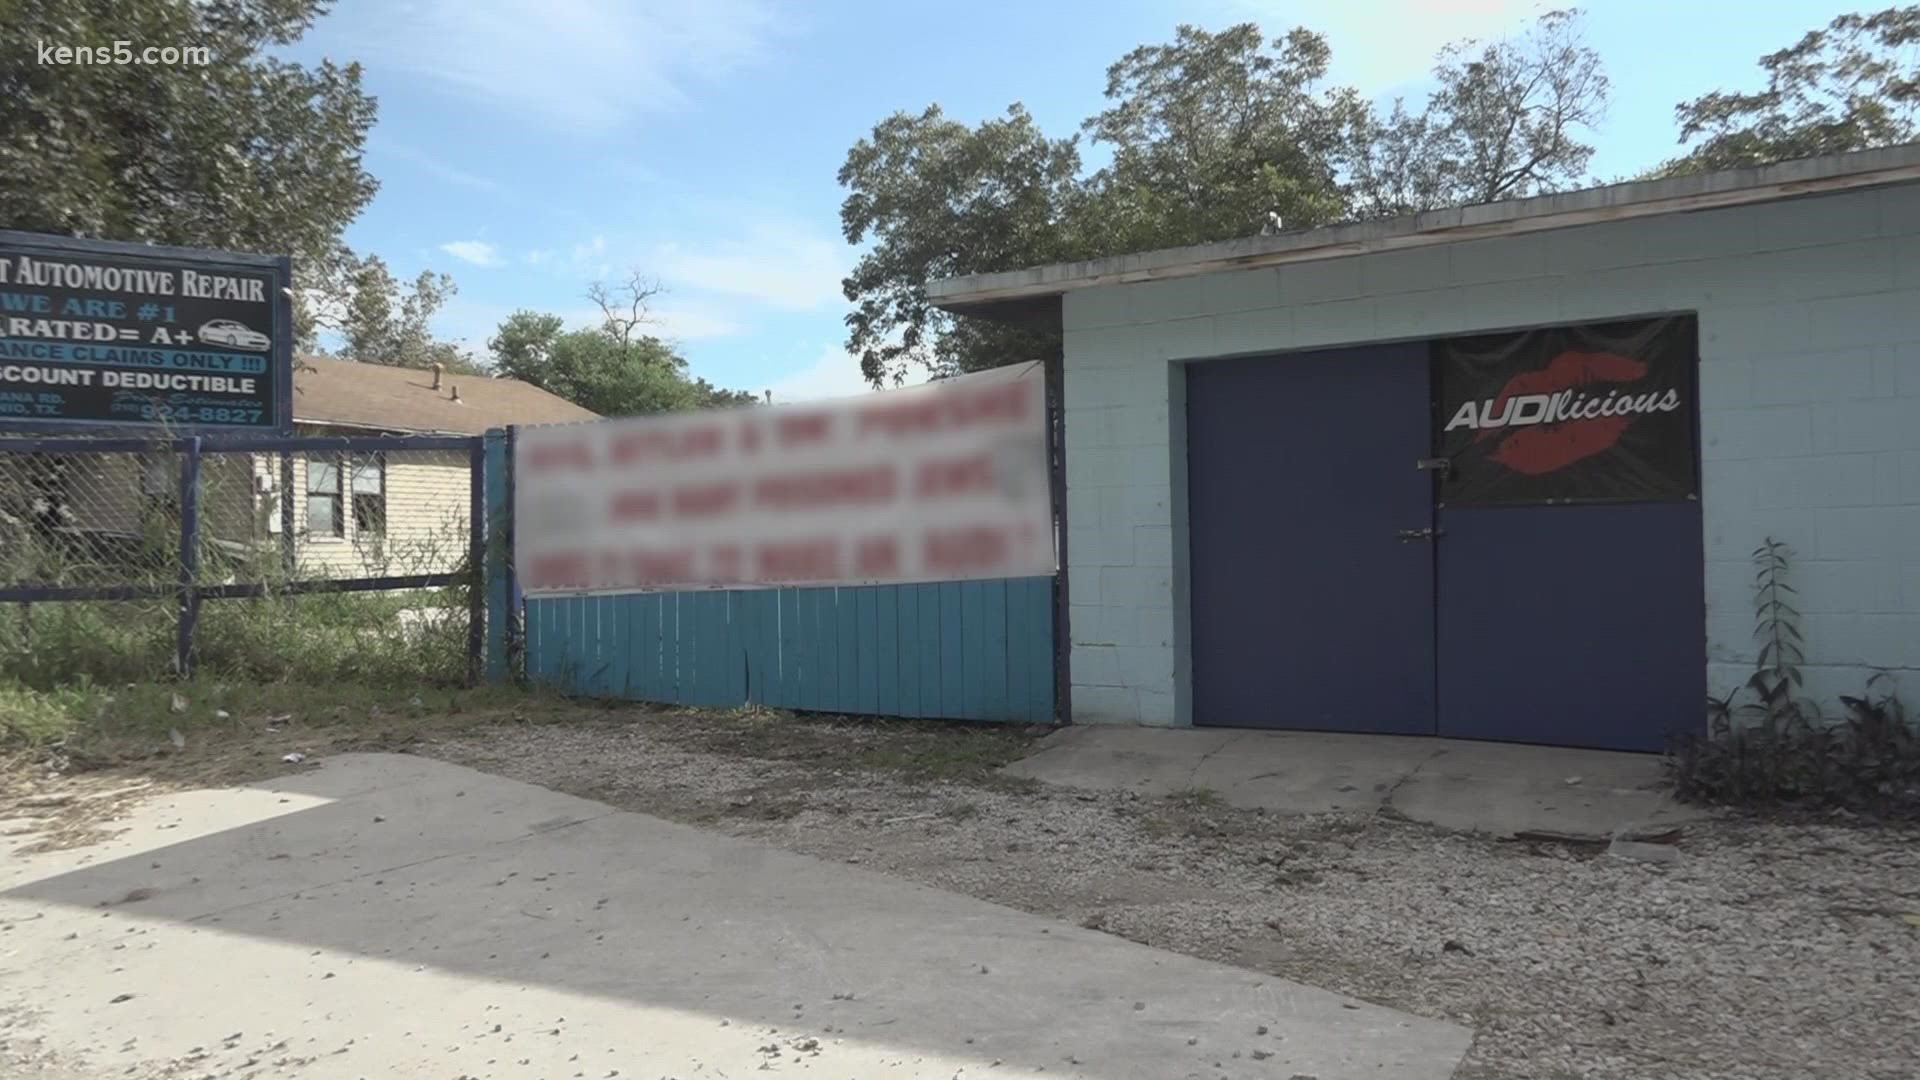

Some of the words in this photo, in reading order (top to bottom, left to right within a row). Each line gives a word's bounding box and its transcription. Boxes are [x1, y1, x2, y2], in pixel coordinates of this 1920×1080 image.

[15, 256, 175, 296] AUTOMOTIVE
[181, 269, 265, 302] REPAIR
[2, 292, 50, 313] WE
[61, 297, 127, 319] ARE
[136, 302, 176, 323] #1
[150, 327, 194, 345] A+
[71, 346, 165, 366] CLAIMS
[172, 352, 234, 370] ONLY
[241, 357, 261, 371] !!!
[102, 371, 257, 393] DEDUCTIBLE
[1444, 388, 1681, 431] AUDIlicious
